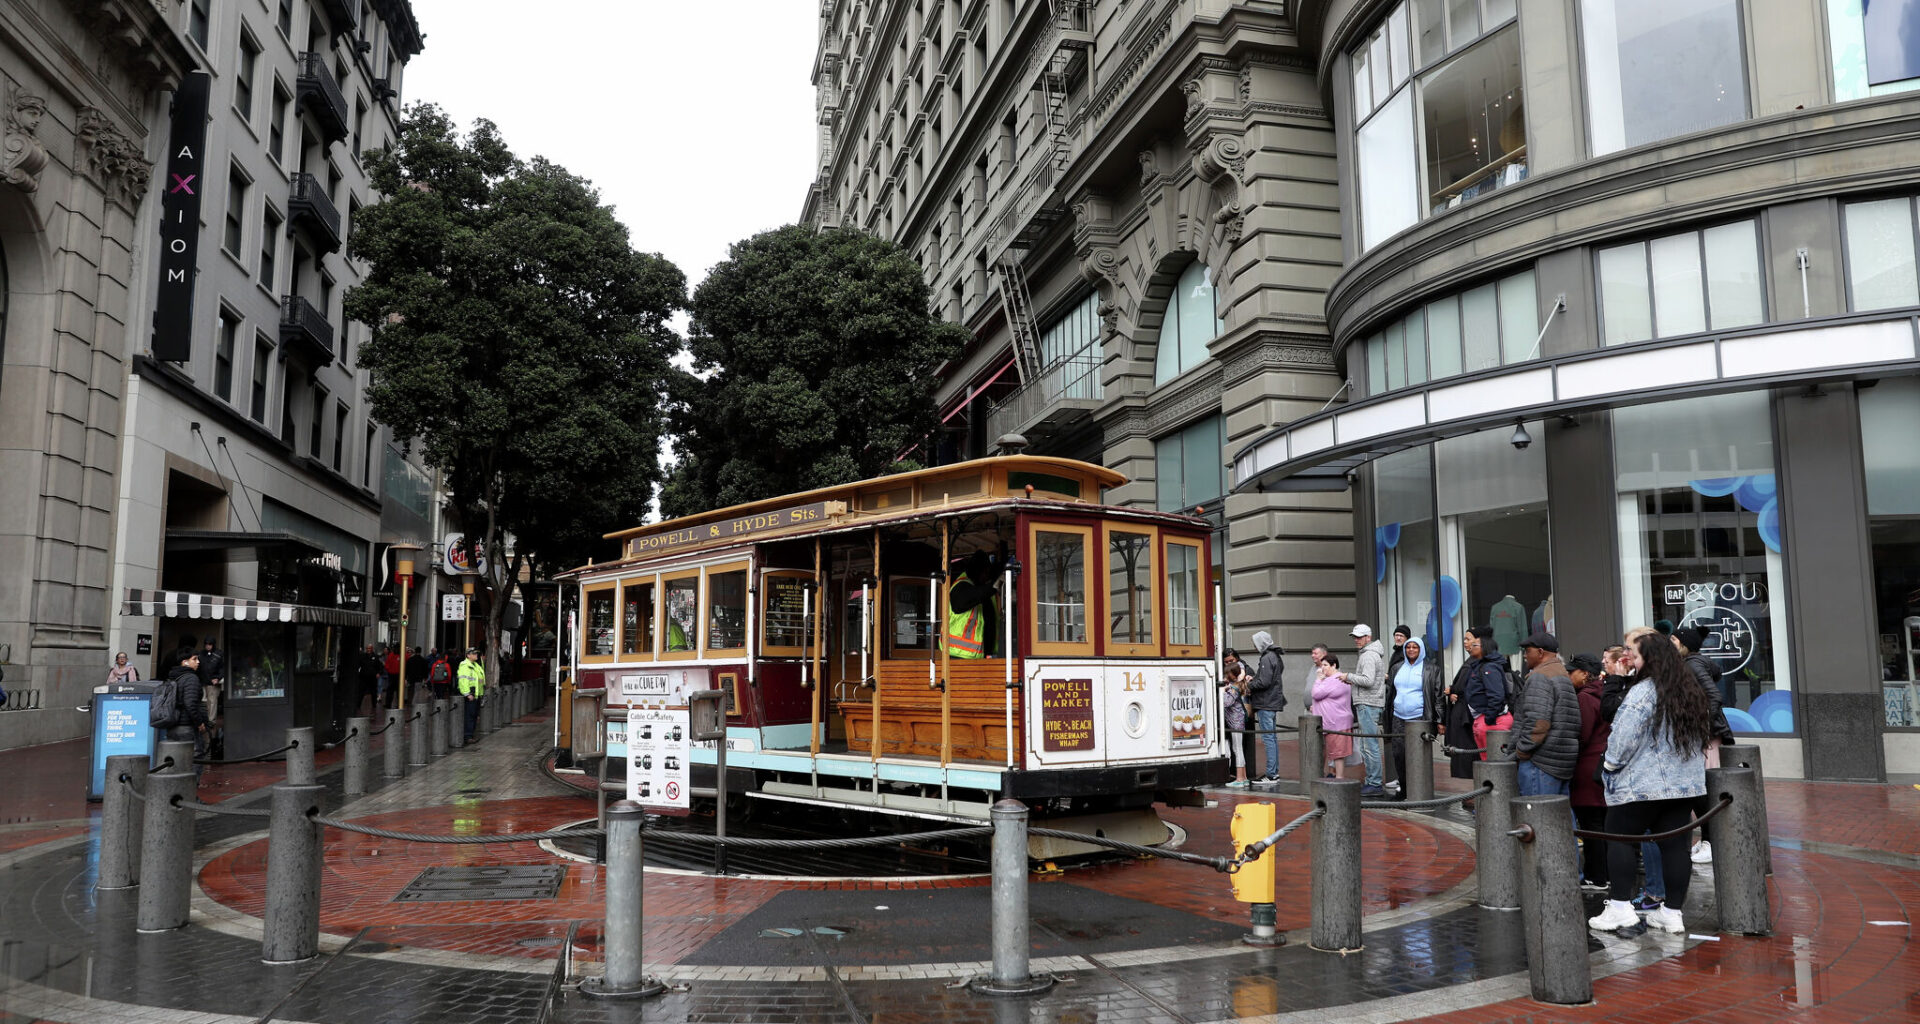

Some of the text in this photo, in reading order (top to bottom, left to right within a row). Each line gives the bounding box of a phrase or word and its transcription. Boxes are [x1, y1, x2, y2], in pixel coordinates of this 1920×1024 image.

[168, 145, 196, 283] AXIOM
[639, 509, 819, 550] POWELL & HYDE Sts.
[1667, 590, 1683, 600] GAP
[1123, 671, 1146, 691] 14
[1044, 682, 1089, 691] POWELL
[1044, 699, 1090, 707] MARKET
[1045, 720, 1062, 731] HYDE
[1071, 720, 1092, 730] BEACH
[1049, 732, 1089, 740] FISHERMANS
[1060, 739, 1079, 747] WHARF
